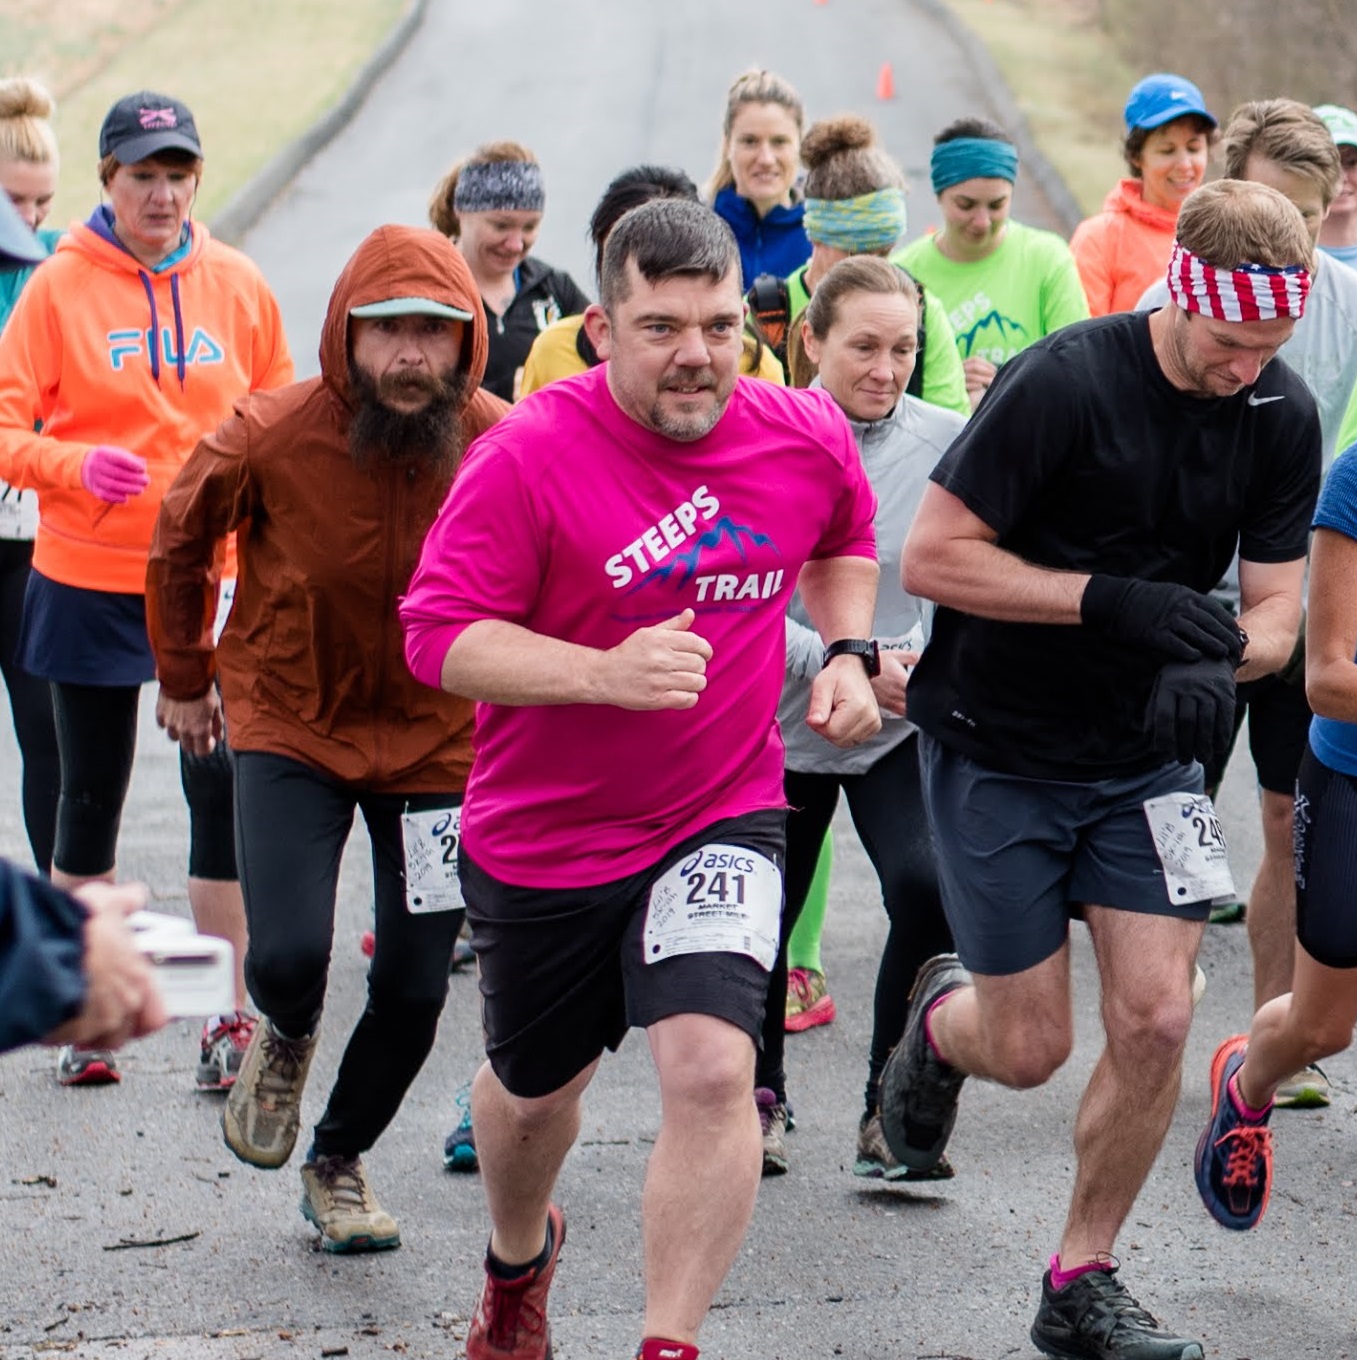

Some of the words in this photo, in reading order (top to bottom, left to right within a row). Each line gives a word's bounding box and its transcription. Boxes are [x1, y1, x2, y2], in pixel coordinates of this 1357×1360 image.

[107, 325, 225, 371] FILA
[604, 485, 720, 588] STEEPS
[695, 569, 784, 603] TRAIL
[703, 853, 755, 873] asics
[686, 871, 745, 905] 241
[687, 910, 724, 919] STREET
[698, 903, 739, 911] MARKET
